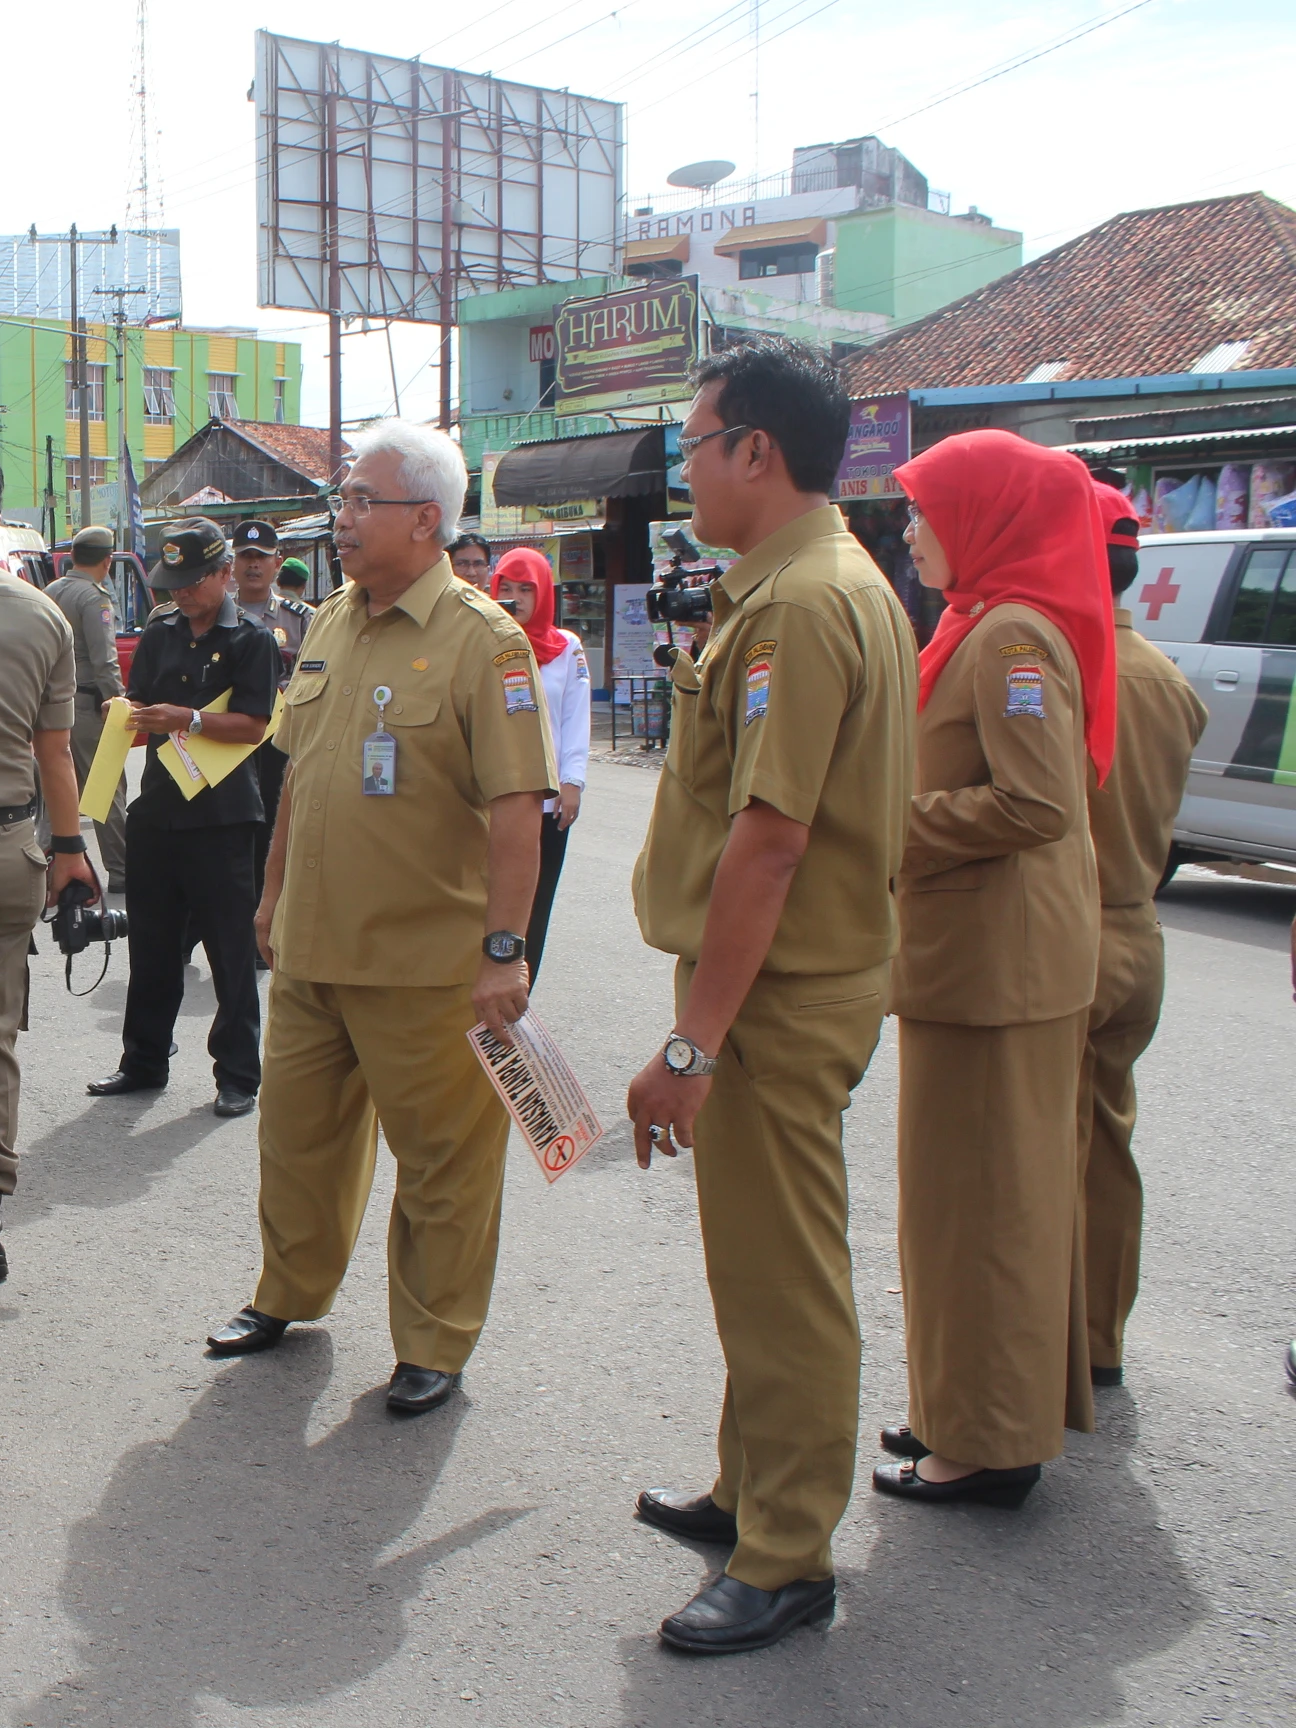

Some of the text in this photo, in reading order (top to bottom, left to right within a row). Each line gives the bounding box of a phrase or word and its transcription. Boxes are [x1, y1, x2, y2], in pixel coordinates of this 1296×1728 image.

[639, 206, 755, 240] RAMONA
[564, 289, 685, 352] HARUM
[848, 421, 900, 439] ANGAROO
[847, 465, 877, 478] TOKO
[840, 480, 867, 496] ANIS
[556, 504, 584, 519] DIBUKA
[495, 1054, 534, 1101] TANPA
[514, 1087, 560, 1151] KAWASAN
